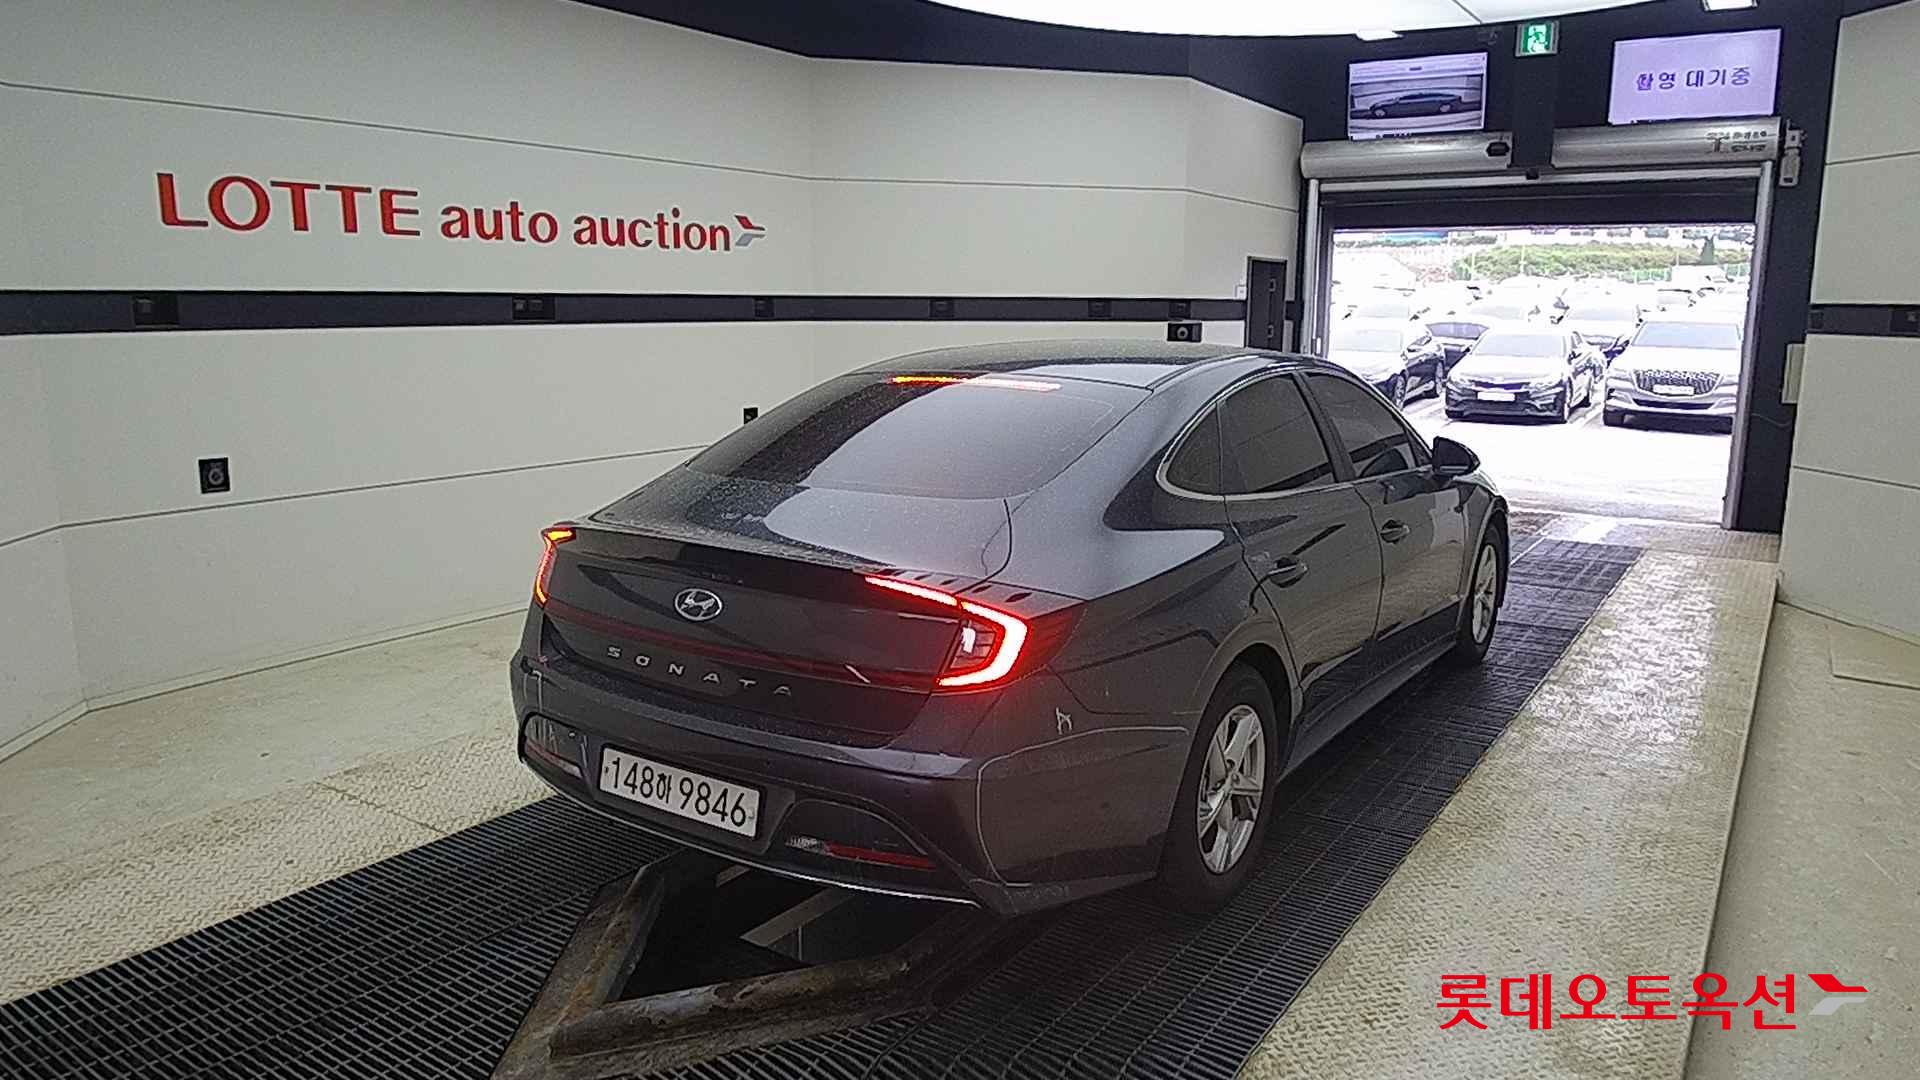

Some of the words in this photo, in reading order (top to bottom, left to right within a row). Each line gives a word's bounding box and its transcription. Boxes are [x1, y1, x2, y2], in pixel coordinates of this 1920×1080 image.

[1685, 66, 1750, 87] 대기중
[156, 172, 421, 237] LOTTE
[439, 201, 558, 244] auto
[572, 207, 732, 252] auction
[607, 646, 792, 697] SONATA
